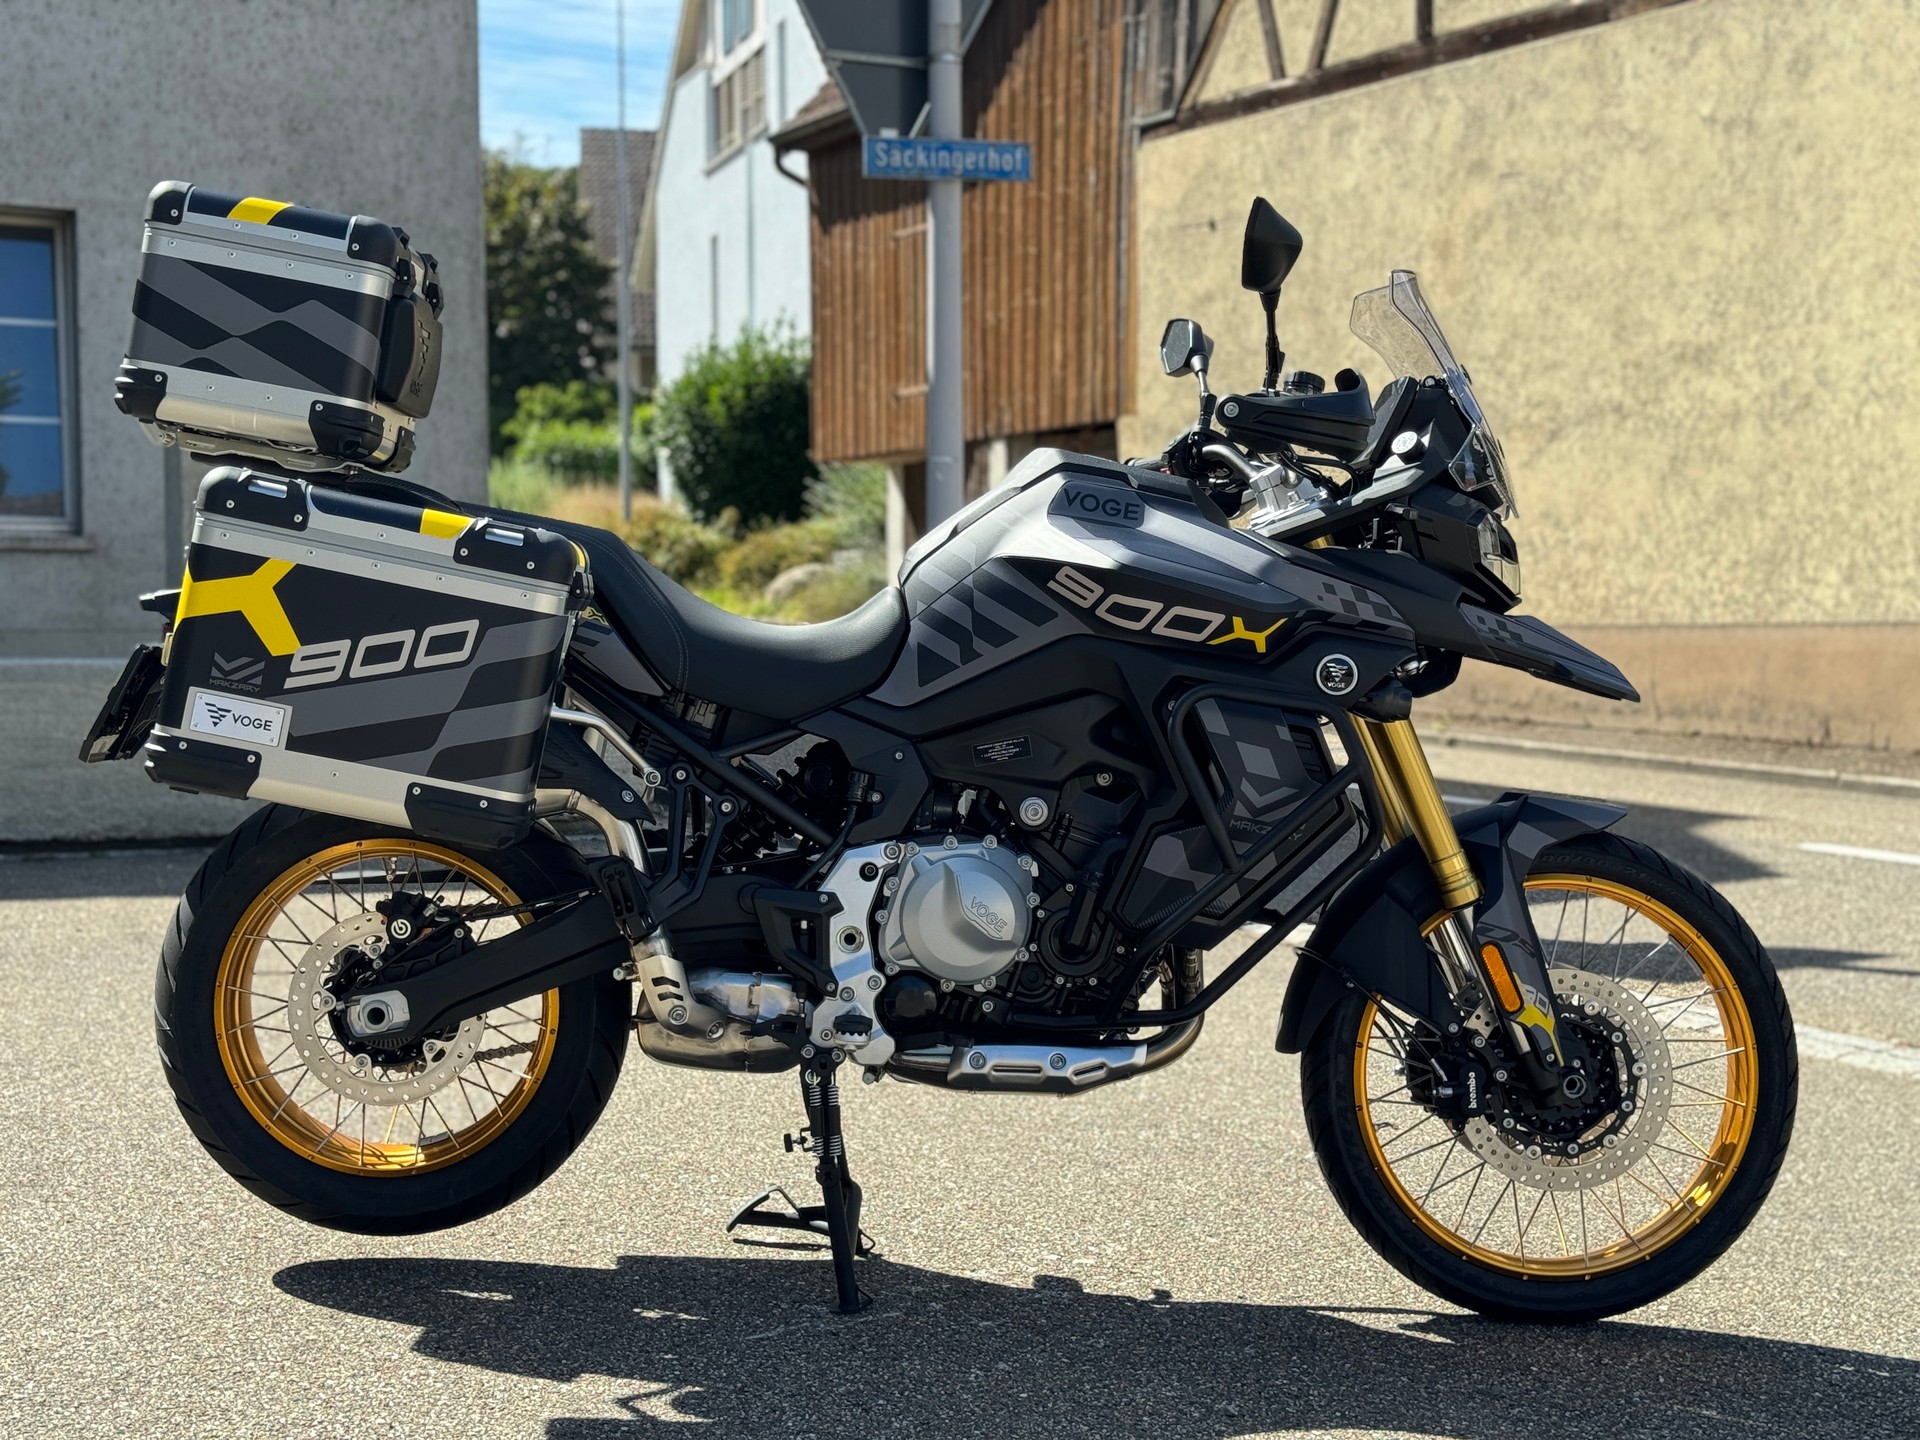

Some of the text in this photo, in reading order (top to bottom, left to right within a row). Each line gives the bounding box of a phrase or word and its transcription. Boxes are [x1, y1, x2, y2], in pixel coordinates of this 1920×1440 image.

[1063, 488, 1141, 521] VOGE
[1046, 565, 1288, 653] 900X
[283, 618, 480, 690] 900
[209, 678, 261, 693] MAKZARY
[1327, 681, 1346, 689] VOGE
[231, 712, 273, 732] VOGE
[1229, 818, 1303, 841] MAKZY
[970, 896, 1008, 933] VOGE
[1468, 1071, 1478, 1109] brembo
